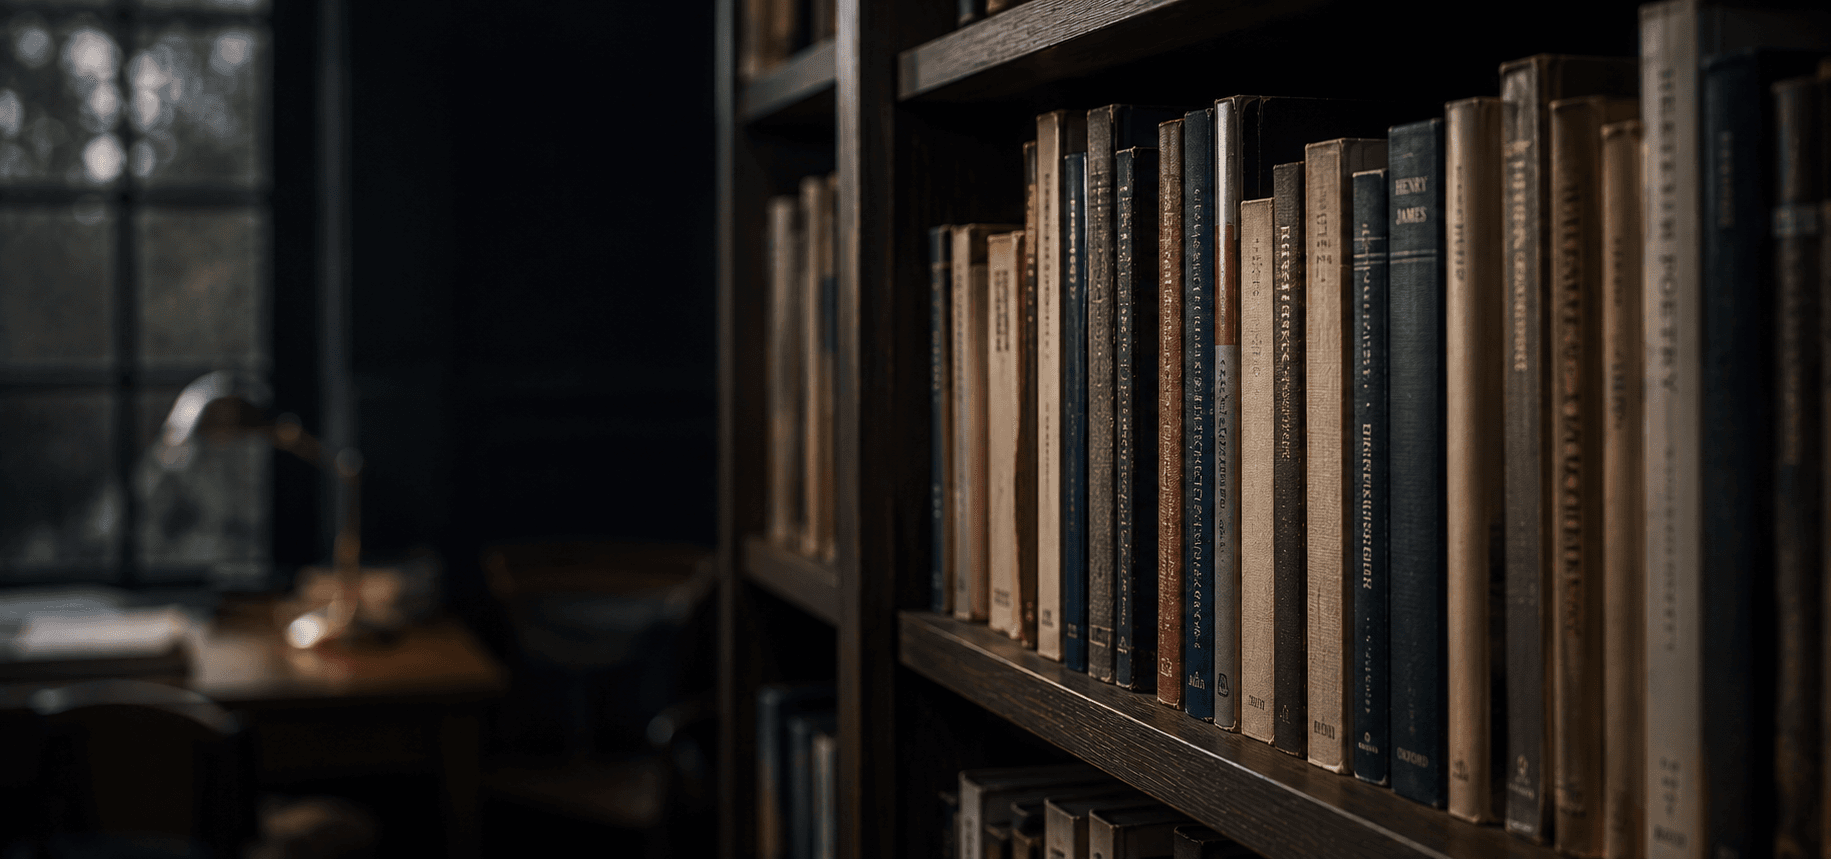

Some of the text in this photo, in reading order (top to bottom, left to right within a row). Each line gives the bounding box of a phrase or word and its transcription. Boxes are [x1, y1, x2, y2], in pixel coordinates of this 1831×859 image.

[1395, 176, 1428, 195] HENRY
[1396, 207, 1427, 225] JAMES
[1659, 254, 1679, 392] POETRY
